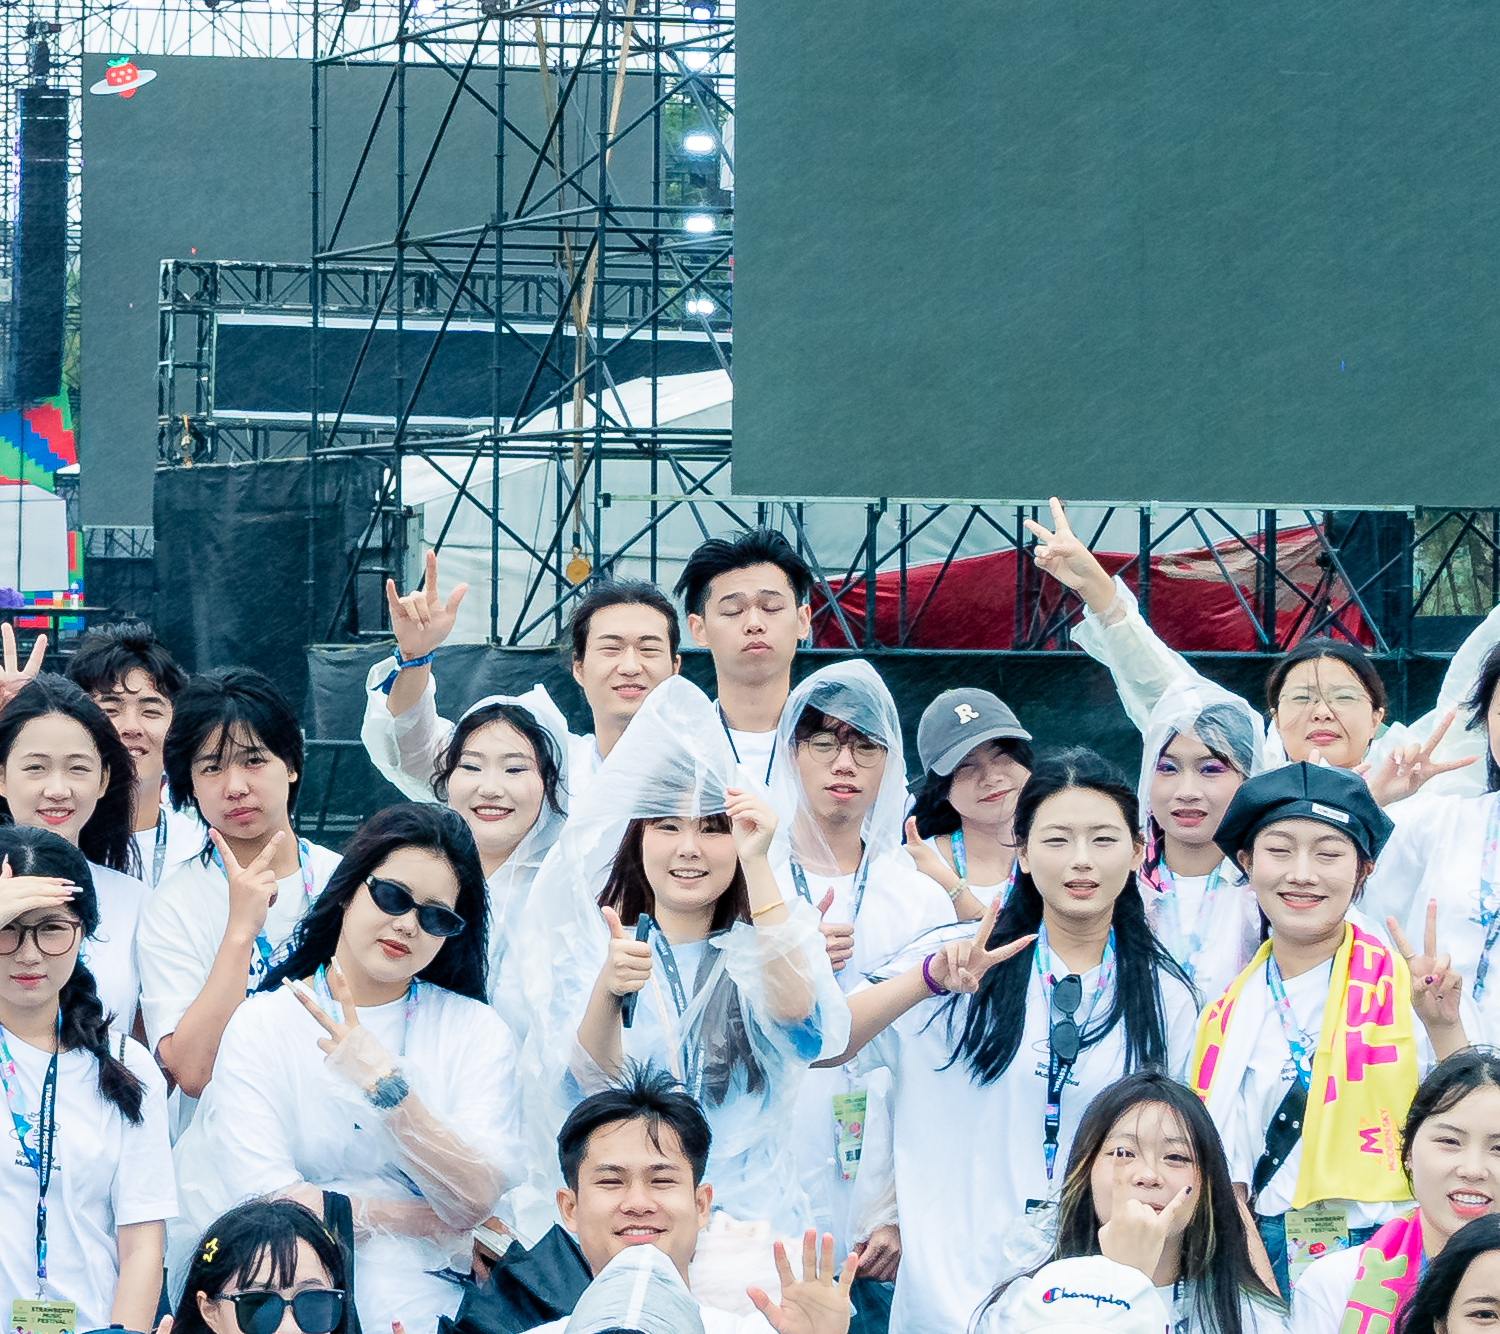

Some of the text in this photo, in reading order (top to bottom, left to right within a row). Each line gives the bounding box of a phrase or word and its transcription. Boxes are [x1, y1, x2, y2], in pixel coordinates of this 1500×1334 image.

[953, 704, 980, 725] R
[1304, 1215, 1345, 1223] STRAWBERRY
[1043, 1287, 1132, 1310] Champion
[31, 1307, 75, 1315] STRAWBERRY
